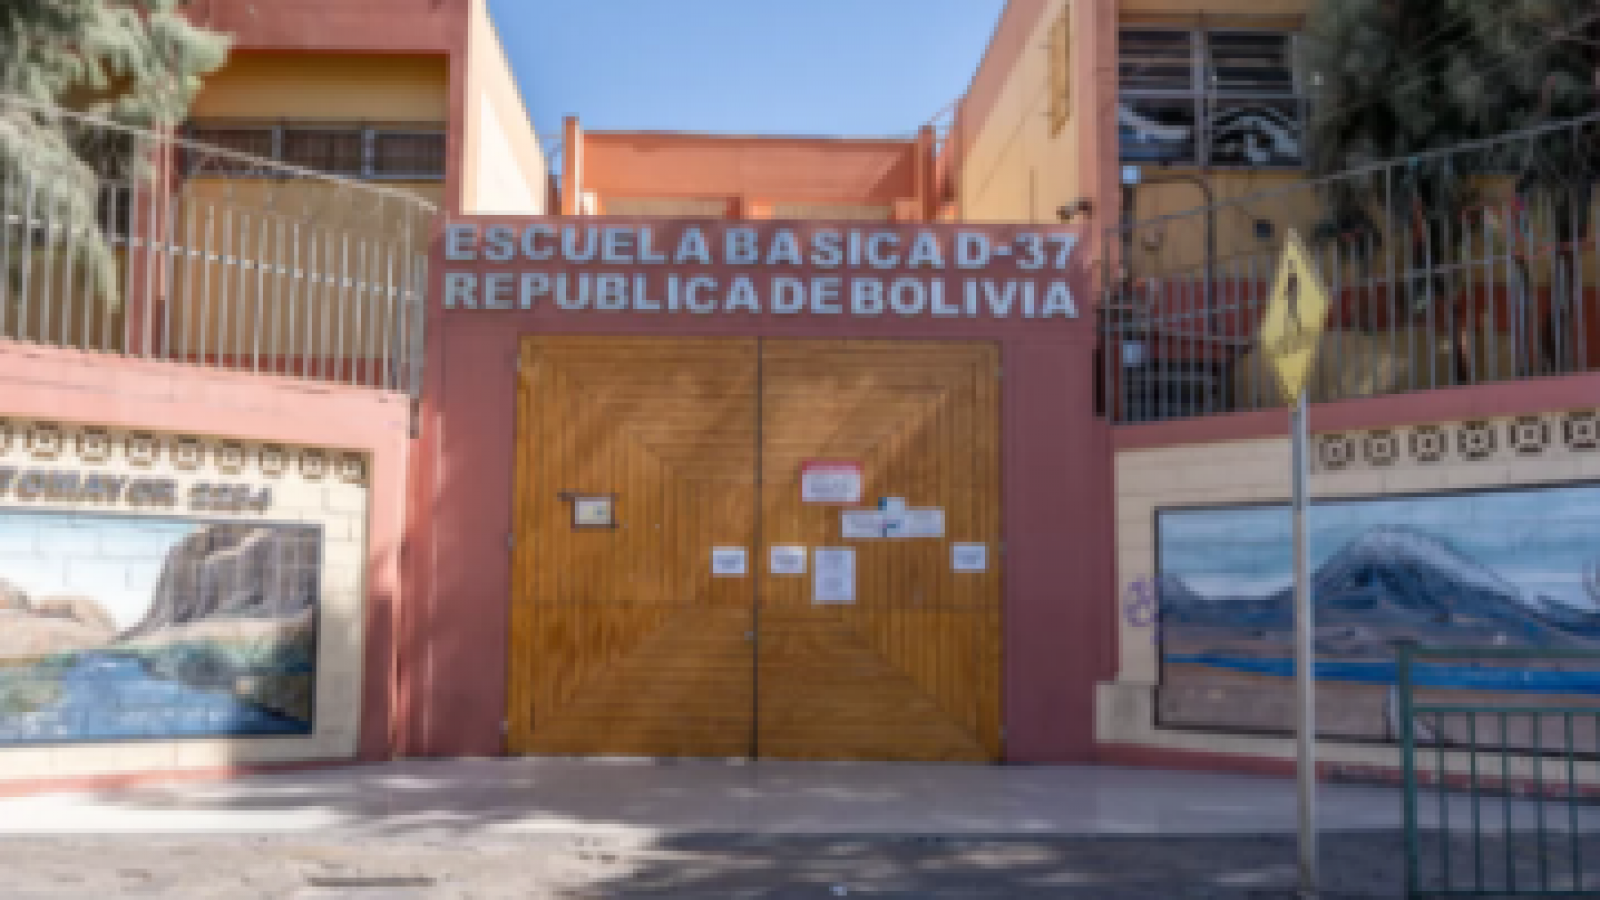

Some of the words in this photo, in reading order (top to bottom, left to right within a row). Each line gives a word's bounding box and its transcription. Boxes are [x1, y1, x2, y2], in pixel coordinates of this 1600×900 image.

[445, 225, 711, 262] ESCUELA
[725, 228, 944, 267] BASICA
[957, 231, 1078, 270] D-37
[444, 272, 762, 313] REPUBLICA
[771, 277, 843, 314] DE
[850, 278, 1079, 318] BOLIVIA
